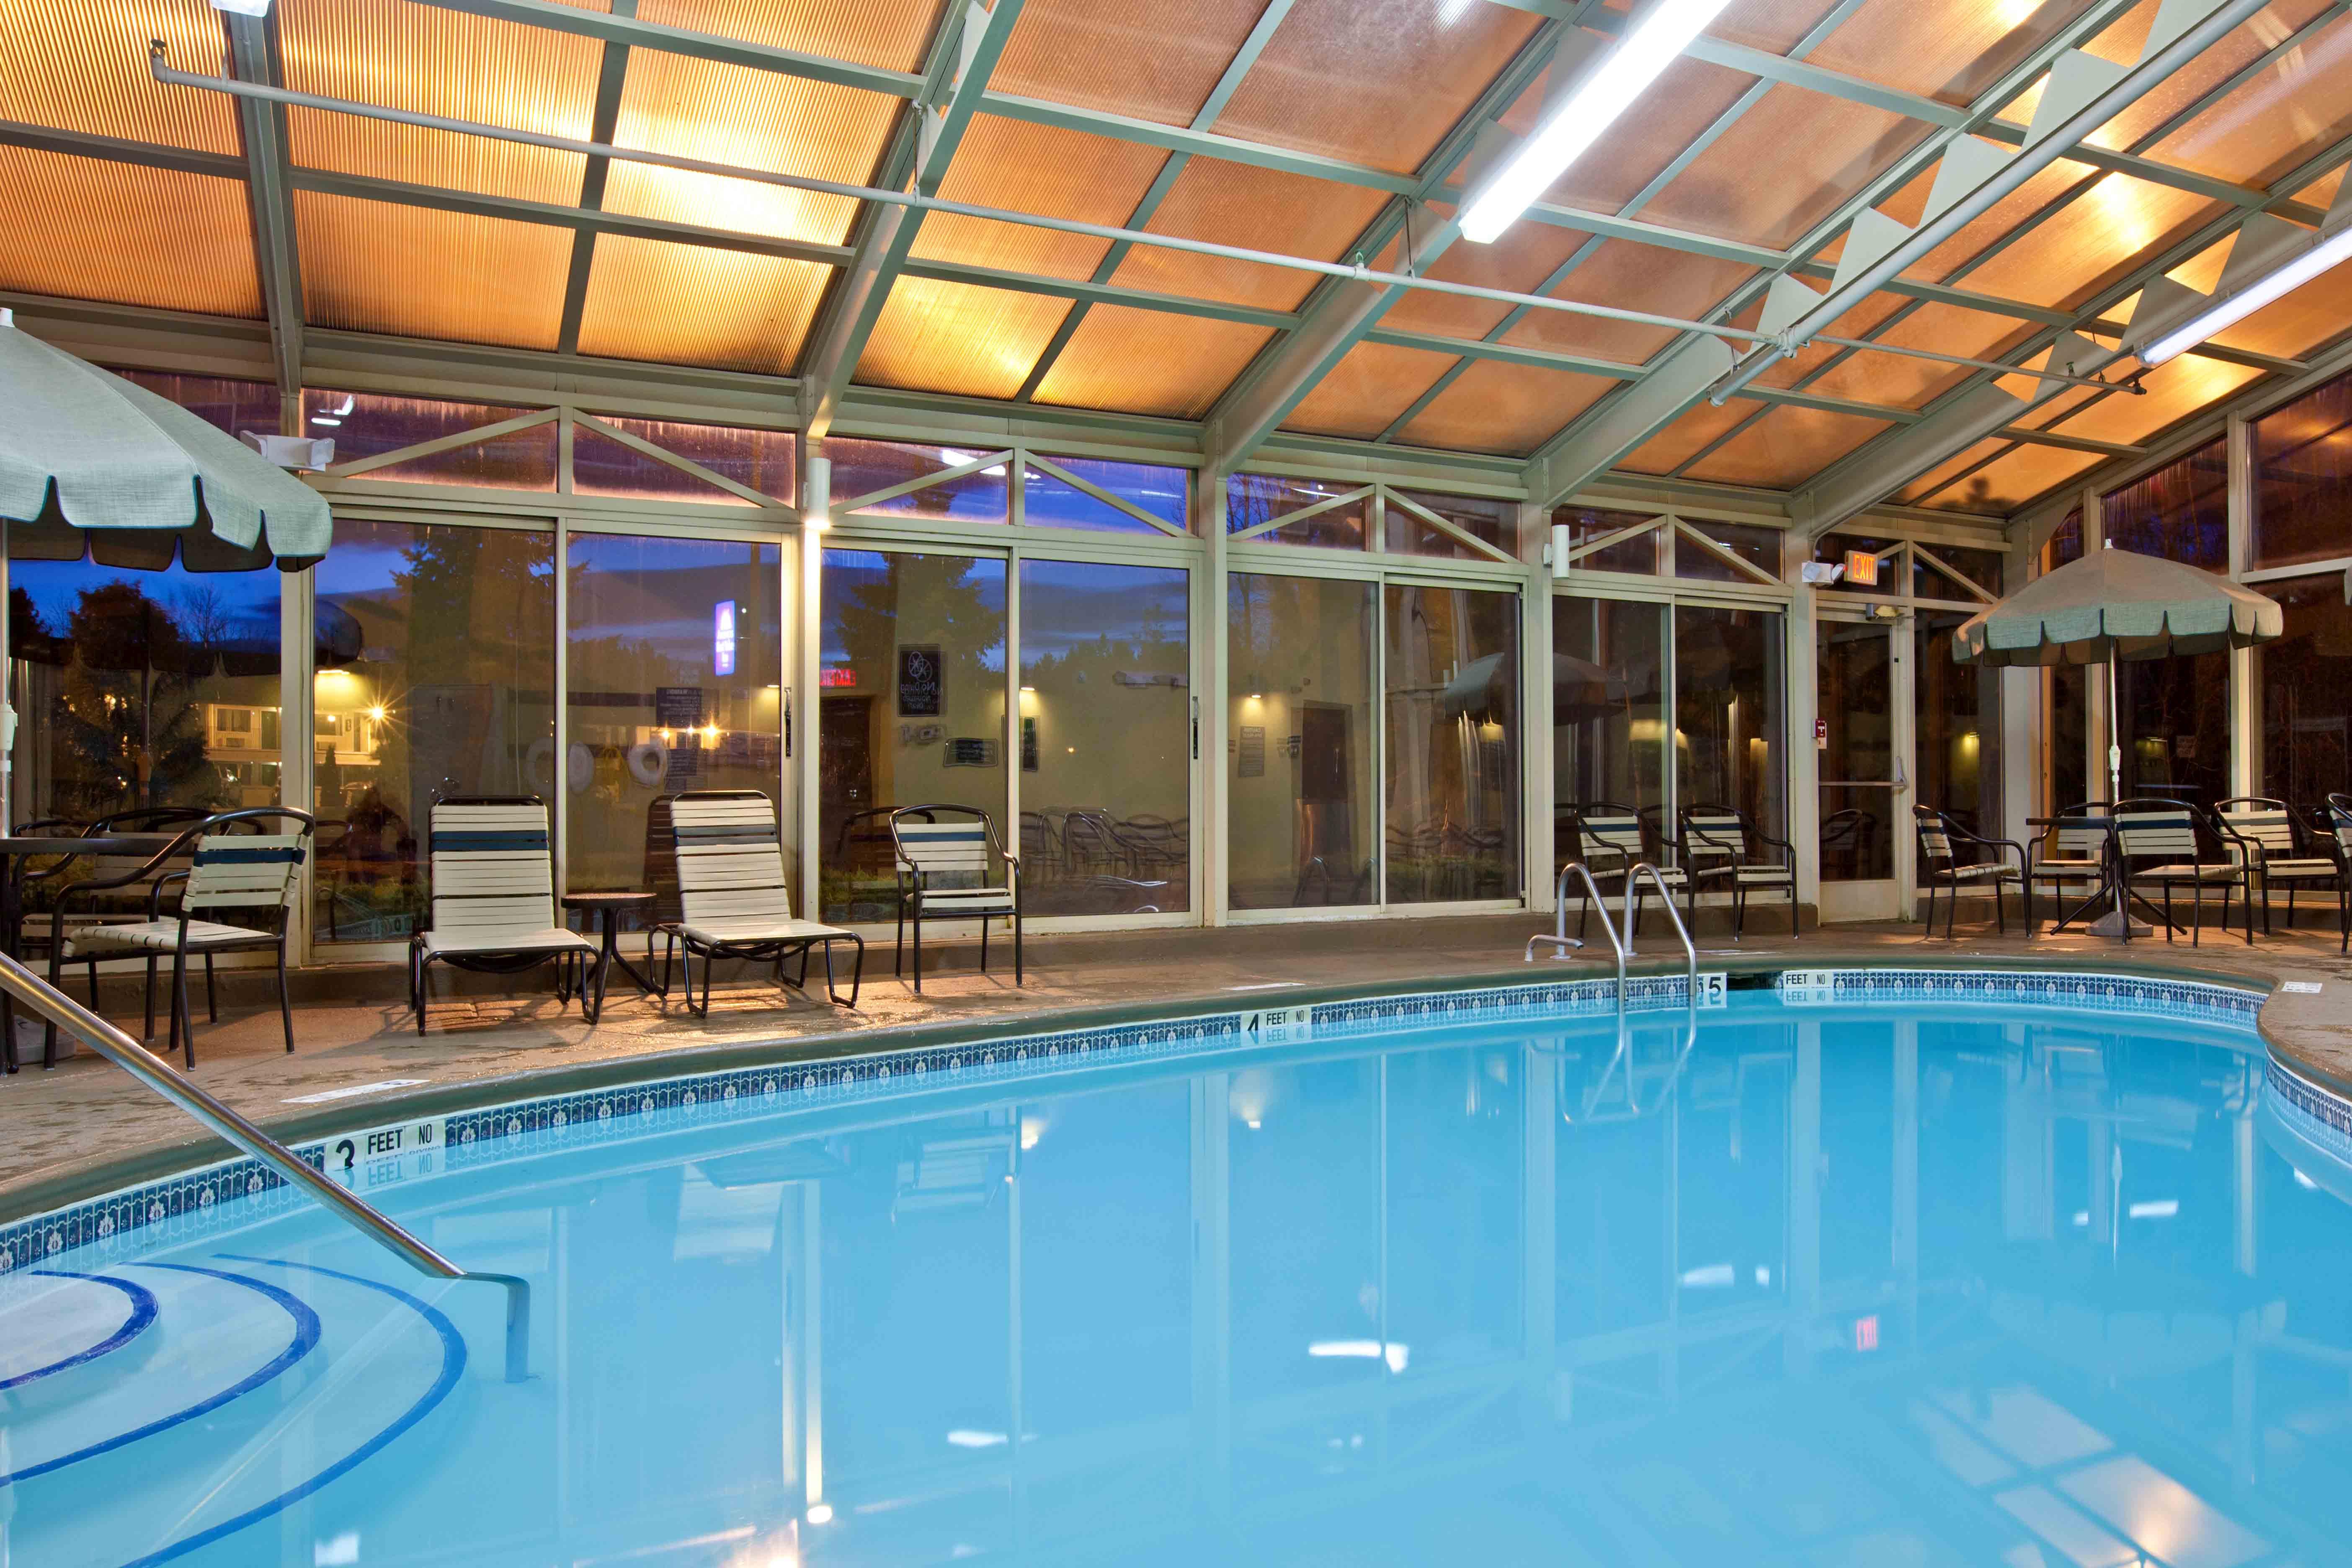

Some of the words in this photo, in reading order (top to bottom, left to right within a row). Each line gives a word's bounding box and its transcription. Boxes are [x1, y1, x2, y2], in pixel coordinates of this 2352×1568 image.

[1853, 554, 1875, 581] EXIT
[1786, 974, 1808, 984] FEET
[1817, 974, 1825, 984] NO
[1266, 1012, 1287, 1026] FEET
[1296, 1010, 1304, 1022] NO
[368, 1129, 403, 1155] FEET
[419, 1124, 432, 1145] NO
